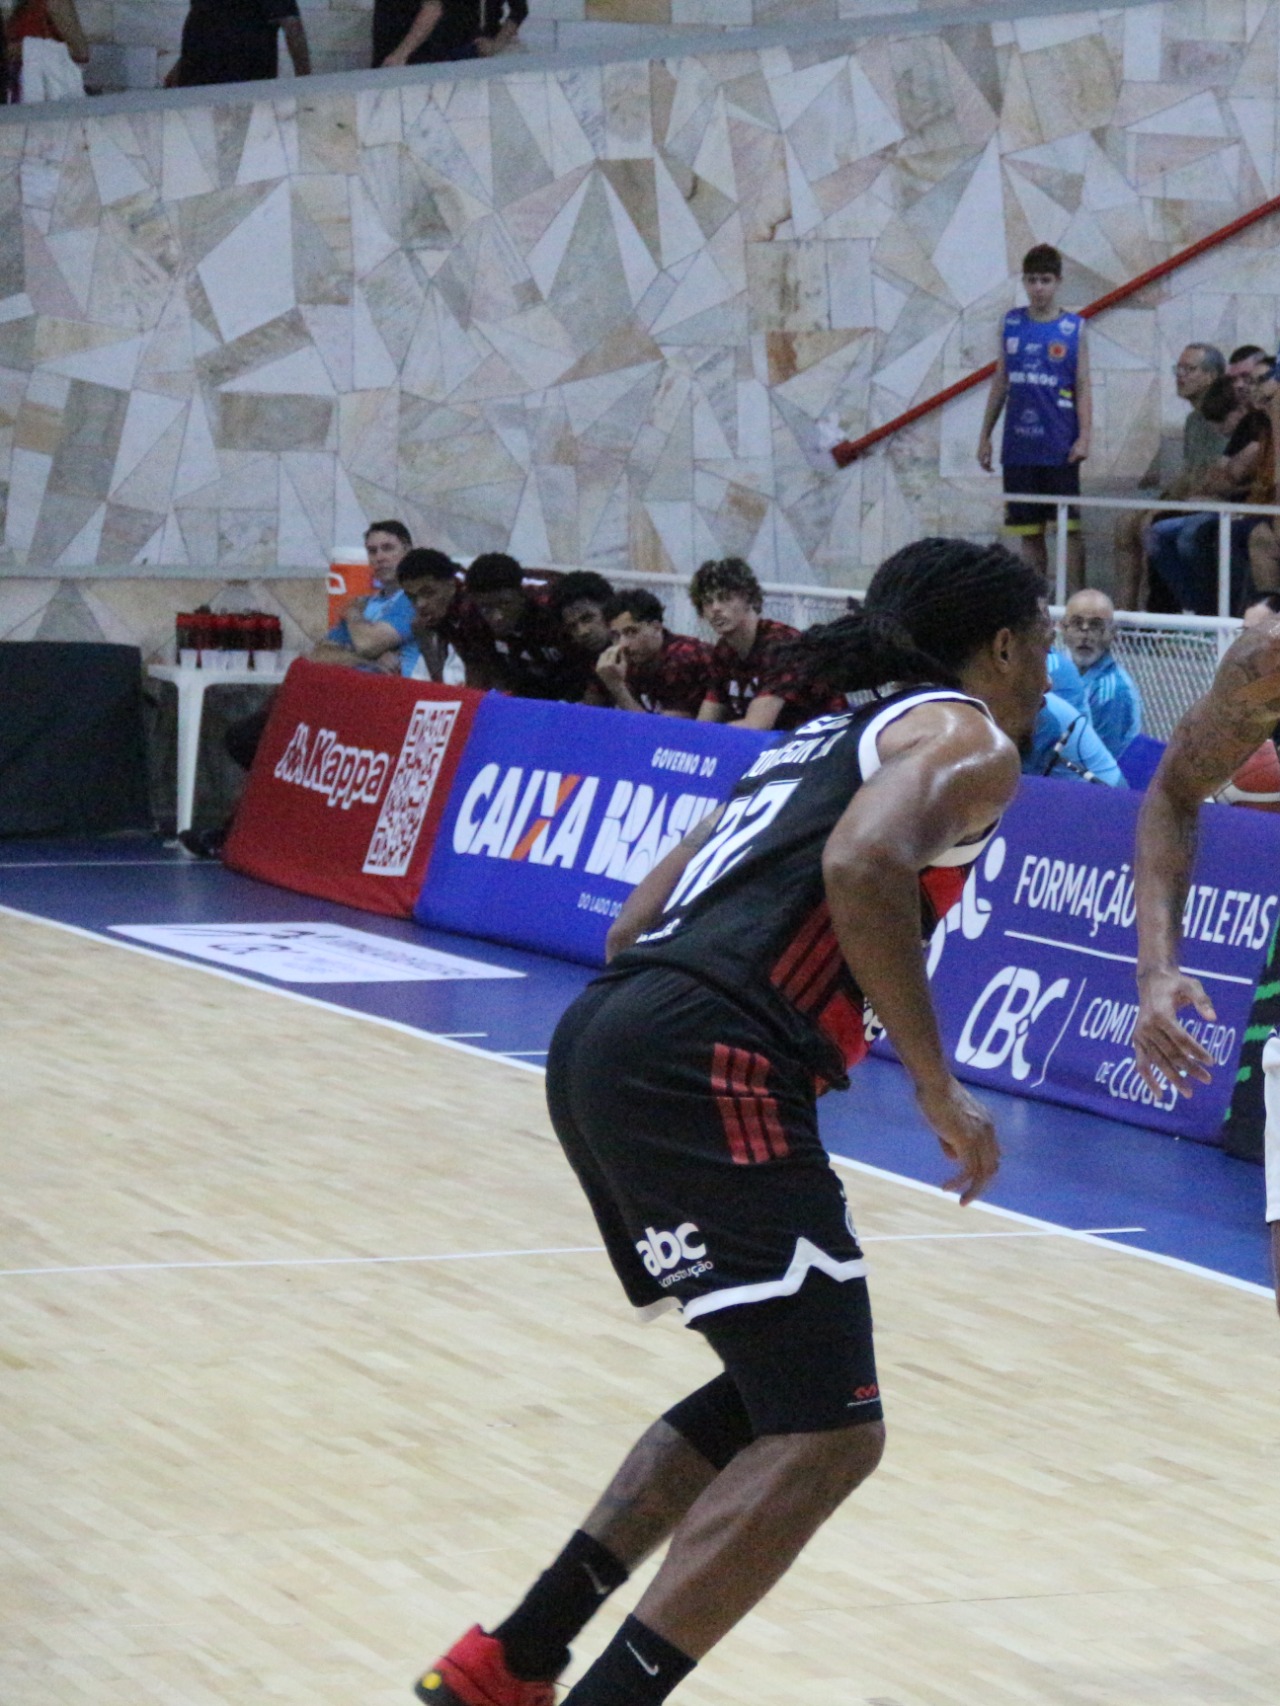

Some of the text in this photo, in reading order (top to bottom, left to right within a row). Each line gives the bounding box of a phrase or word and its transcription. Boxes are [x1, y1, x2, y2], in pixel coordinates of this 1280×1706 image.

[302, 727, 390, 810] Kappa
[651, 747, 718, 778] GOVERNO DO
[453, 763, 599, 869] CAIXA
[1013, 855, 1278, 950] FORMAÇÃO ATLETAS
[1079, 997, 1138, 1048] COMIT
[635, 1222, 707, 1277] abc
